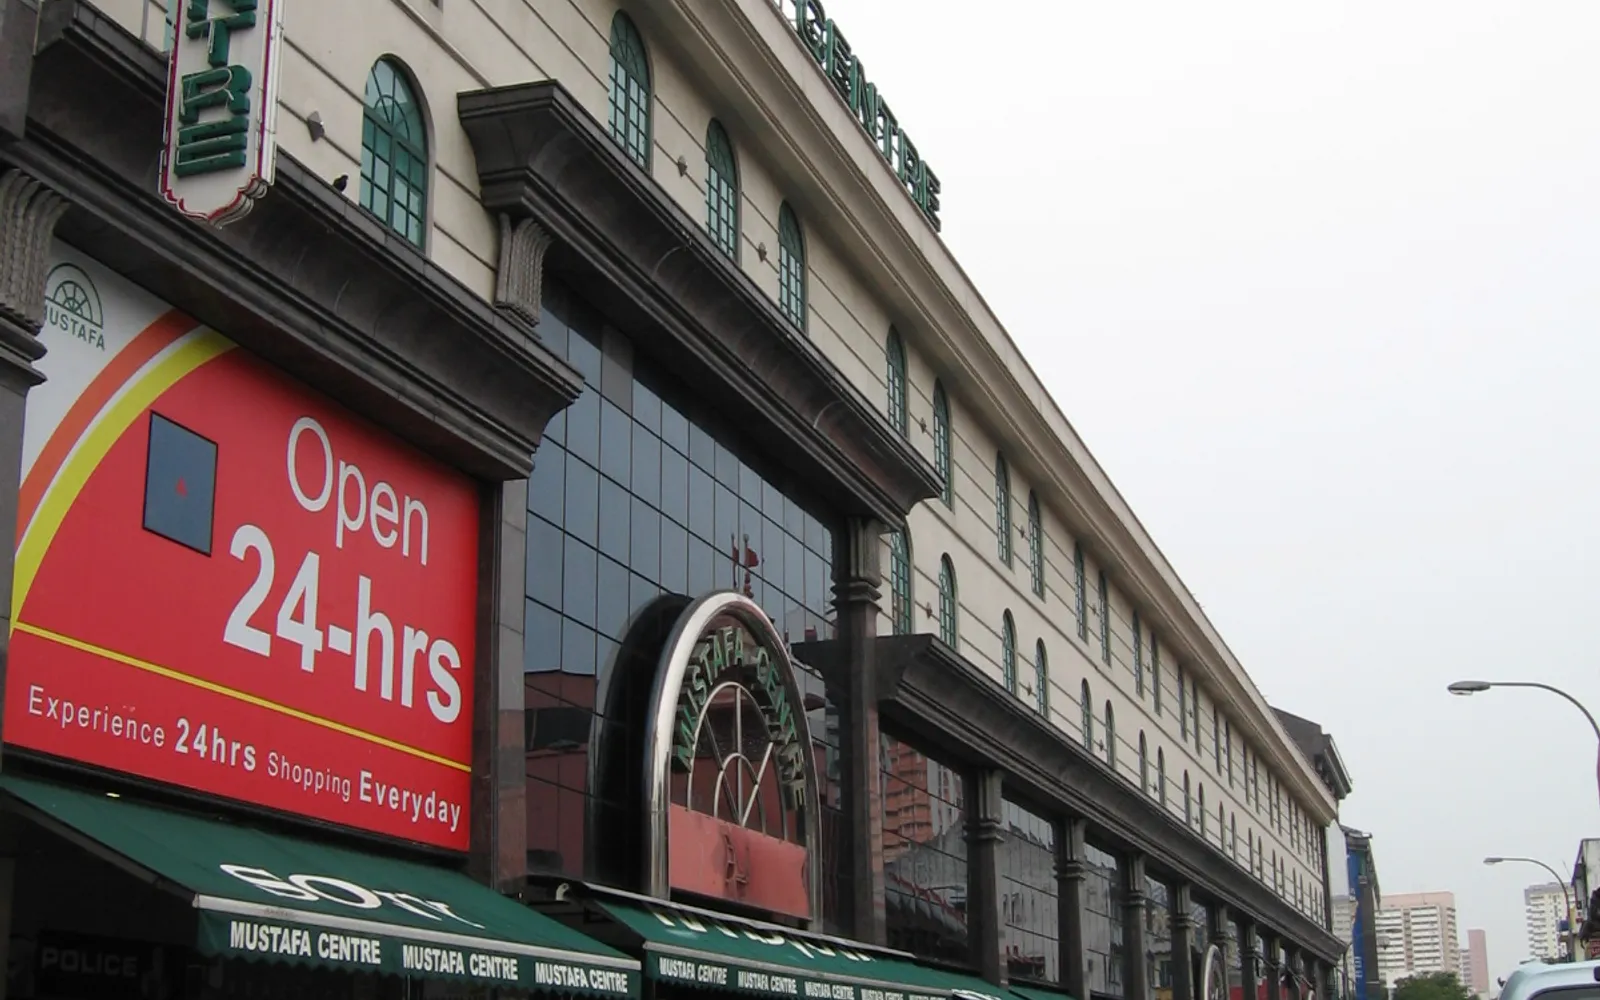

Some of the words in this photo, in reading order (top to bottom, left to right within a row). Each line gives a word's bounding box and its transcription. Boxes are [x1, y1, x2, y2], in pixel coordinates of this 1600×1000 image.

[795, 0, 941, 233] CENTRE
[44, 304, 106, 352] USTAFA
[287, 416, 430, 567] Open
[223, 524, 462, 724] 24-hrs
[675, 626, 744, 774] MUSTAFA
[755, 645, 807, 811] CENTRE
[28, 684, 166, 748] Experience
[174, 717, 257, 772] 24hrs
[267, 751, 351, 803] Shopping
[359, 769, 462, 832] Everyday
[40, 945, 138, 977] POLICE
[230, 920, 312, 958] MUSTAFA
[317, 932, 382, 965] CENTRE
[402, 944, 466, 976] MUSTAFA
[469, 953, 519, 981] CENTRE
[535, 962, 590, 988] MUSTAFA
[589, 969, 629, 993] CENTRE
[658, 957, 697, 980] MUSTAFA
[697, 964, 728, 985] CENTRE
[737, 971, 770, 991] MUSTAFA
[770, 976, 798, 994] CENTRE
